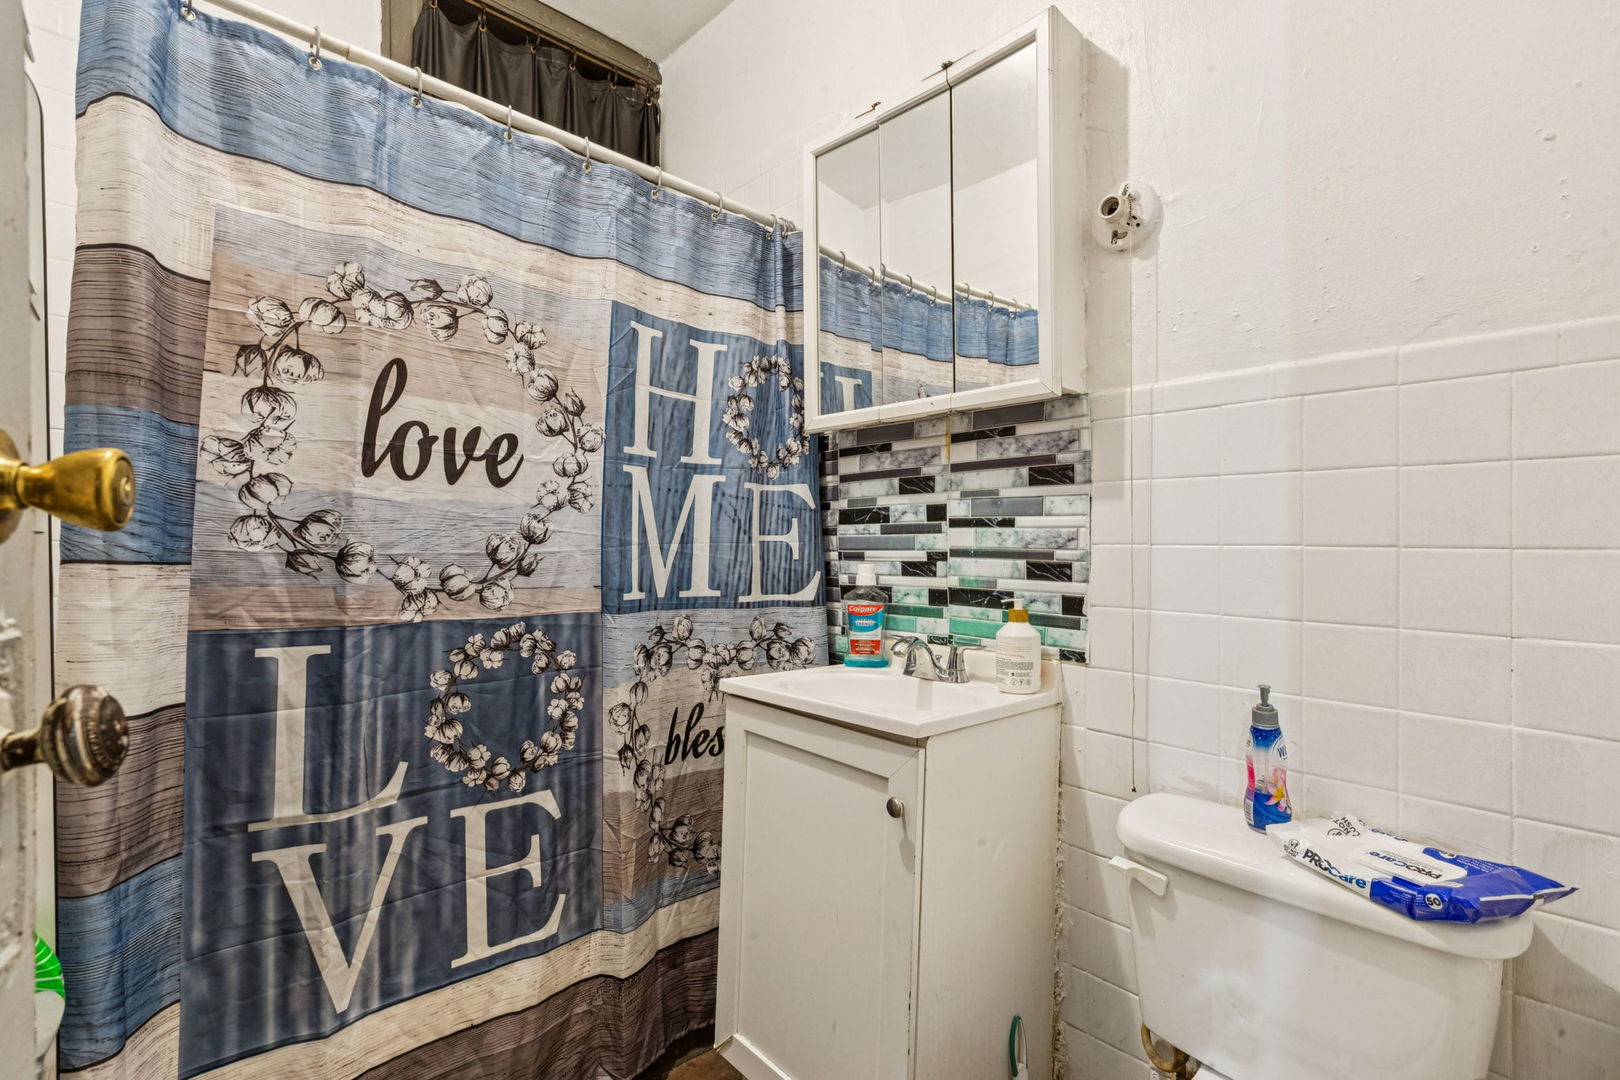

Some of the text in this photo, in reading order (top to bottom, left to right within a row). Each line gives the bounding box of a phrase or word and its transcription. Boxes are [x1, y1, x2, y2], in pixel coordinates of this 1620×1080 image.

[361, 357, 524, 488] love
[849, 605, 877, 613] Colgate
[664, 702, 724, 765] bles
[1426, 896, 1441, 907] 50
